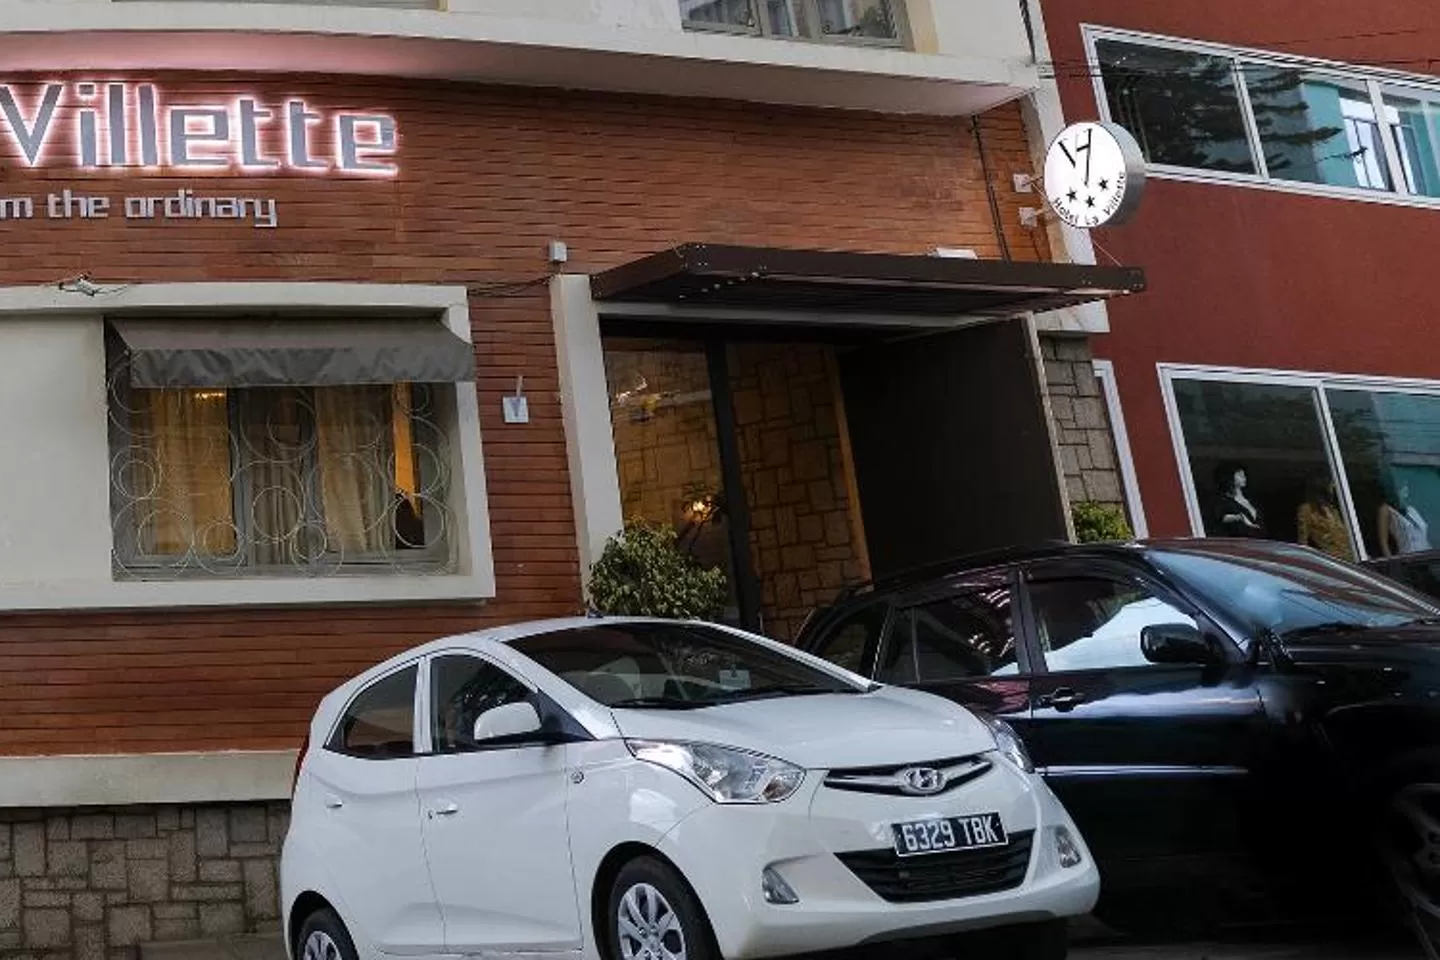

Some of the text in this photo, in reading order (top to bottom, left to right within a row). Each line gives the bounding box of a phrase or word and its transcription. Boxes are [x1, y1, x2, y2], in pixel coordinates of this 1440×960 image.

[47, 189, 110, 219] the
[124, 189, 278, 228] ordinary
[902, 815, 999, 851] 6329 TBK
